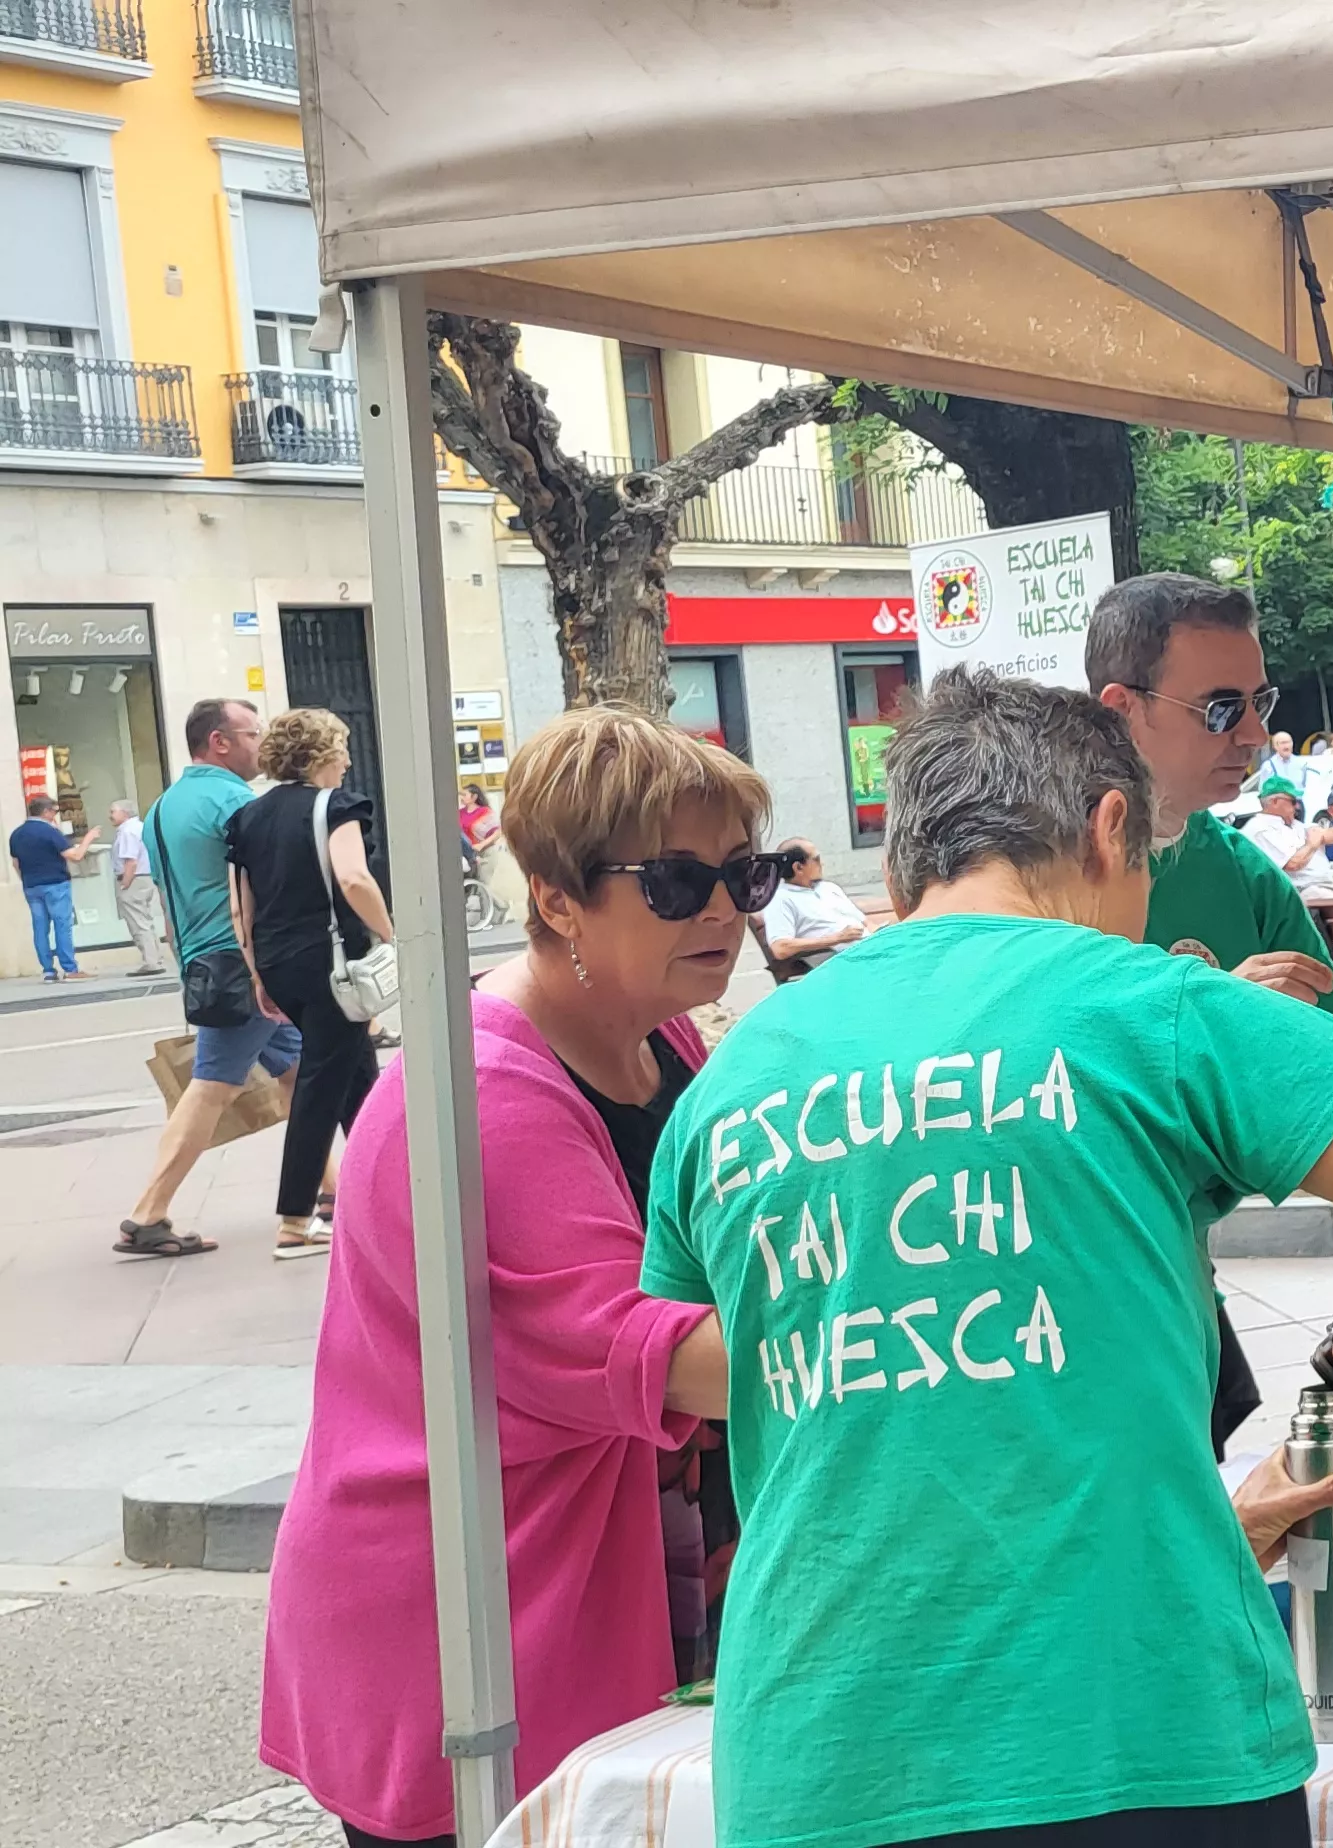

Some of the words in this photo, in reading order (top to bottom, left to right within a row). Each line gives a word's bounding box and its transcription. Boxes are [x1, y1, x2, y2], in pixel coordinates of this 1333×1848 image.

[1007, 532, 1094, 574] ESCUELA
[339, 582, 350, 600] 2
[1019, 575, 1046, 605] TAI
[1056, 569, 1085, 600] CHI
[13, 620, 74, 646] Pilar
[1018, 602, 1092, 639] HUESCA
[711, 1047, 1078, 1205] ESCUELA
[750, 1193, 848, 1301] TAI
[890, 1165, 1033, 1265] CHI
[757, 1285, 1066, 1421] HUESCA
